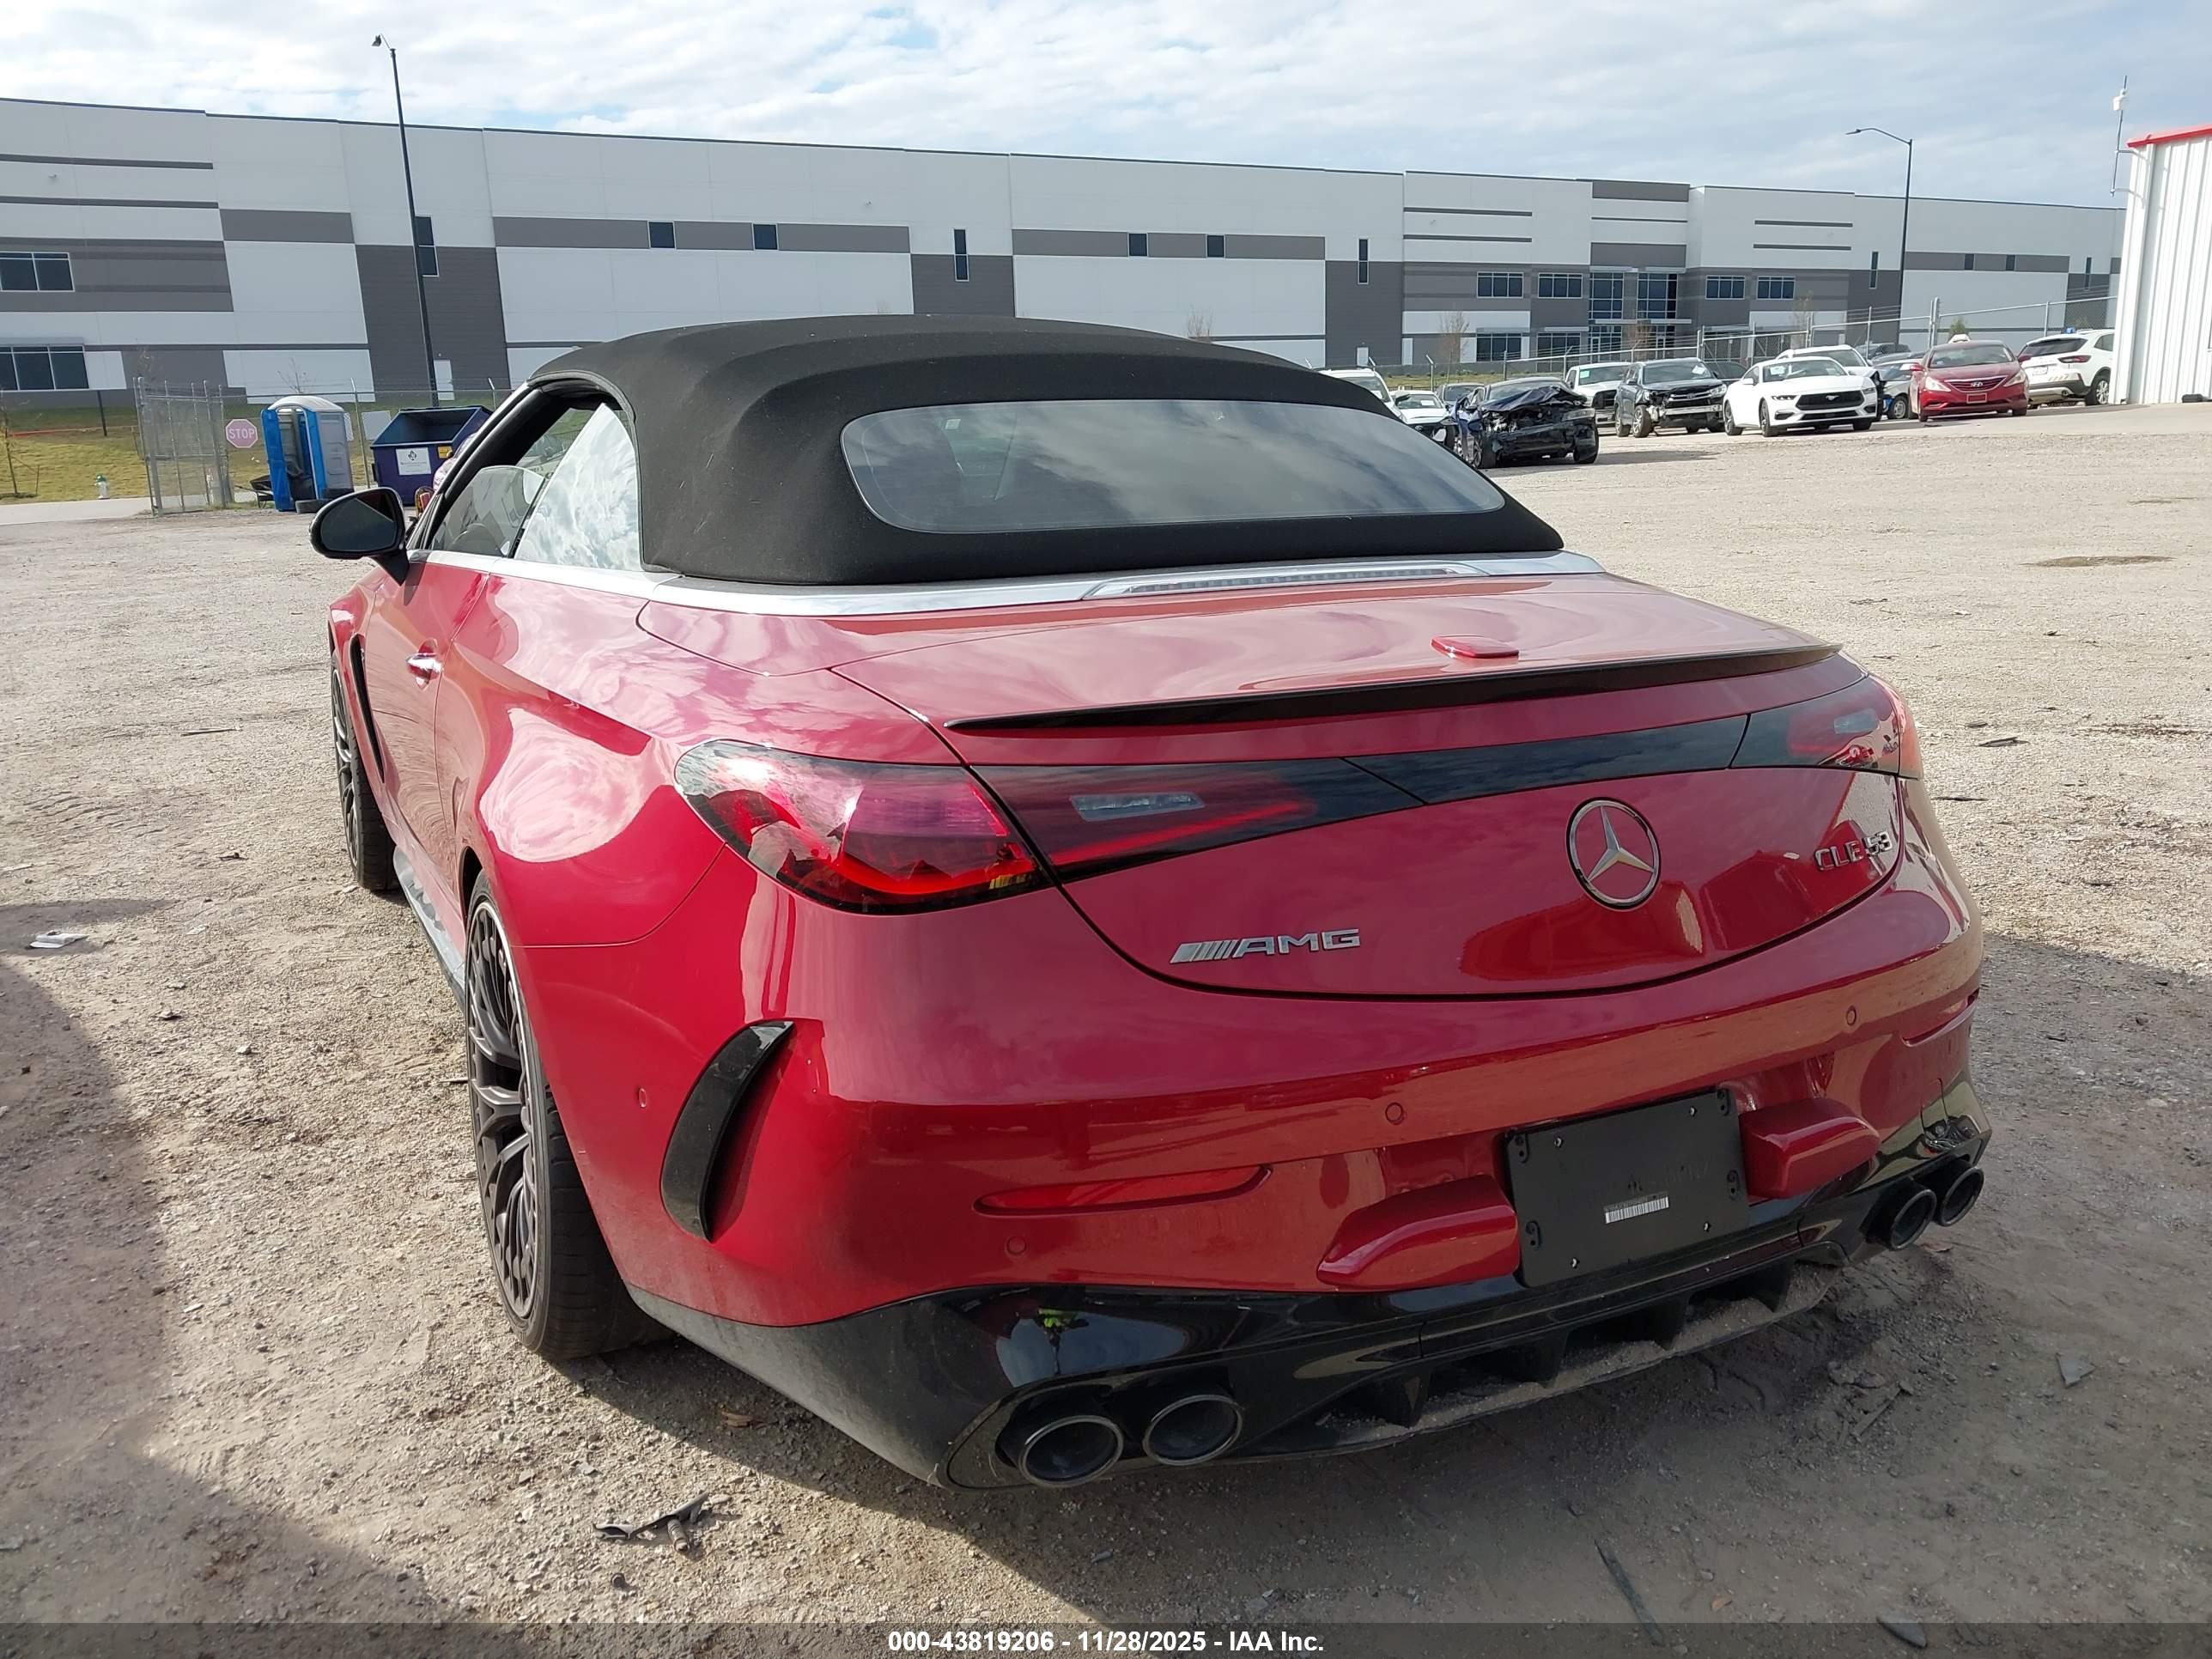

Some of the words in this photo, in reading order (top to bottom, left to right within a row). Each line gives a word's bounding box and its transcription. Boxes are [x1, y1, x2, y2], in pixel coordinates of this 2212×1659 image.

[228, 428, 255, 439] STOP
[1814, 840, 1865, 871] CLE
[1232, 928, 1361, 958] AMG
